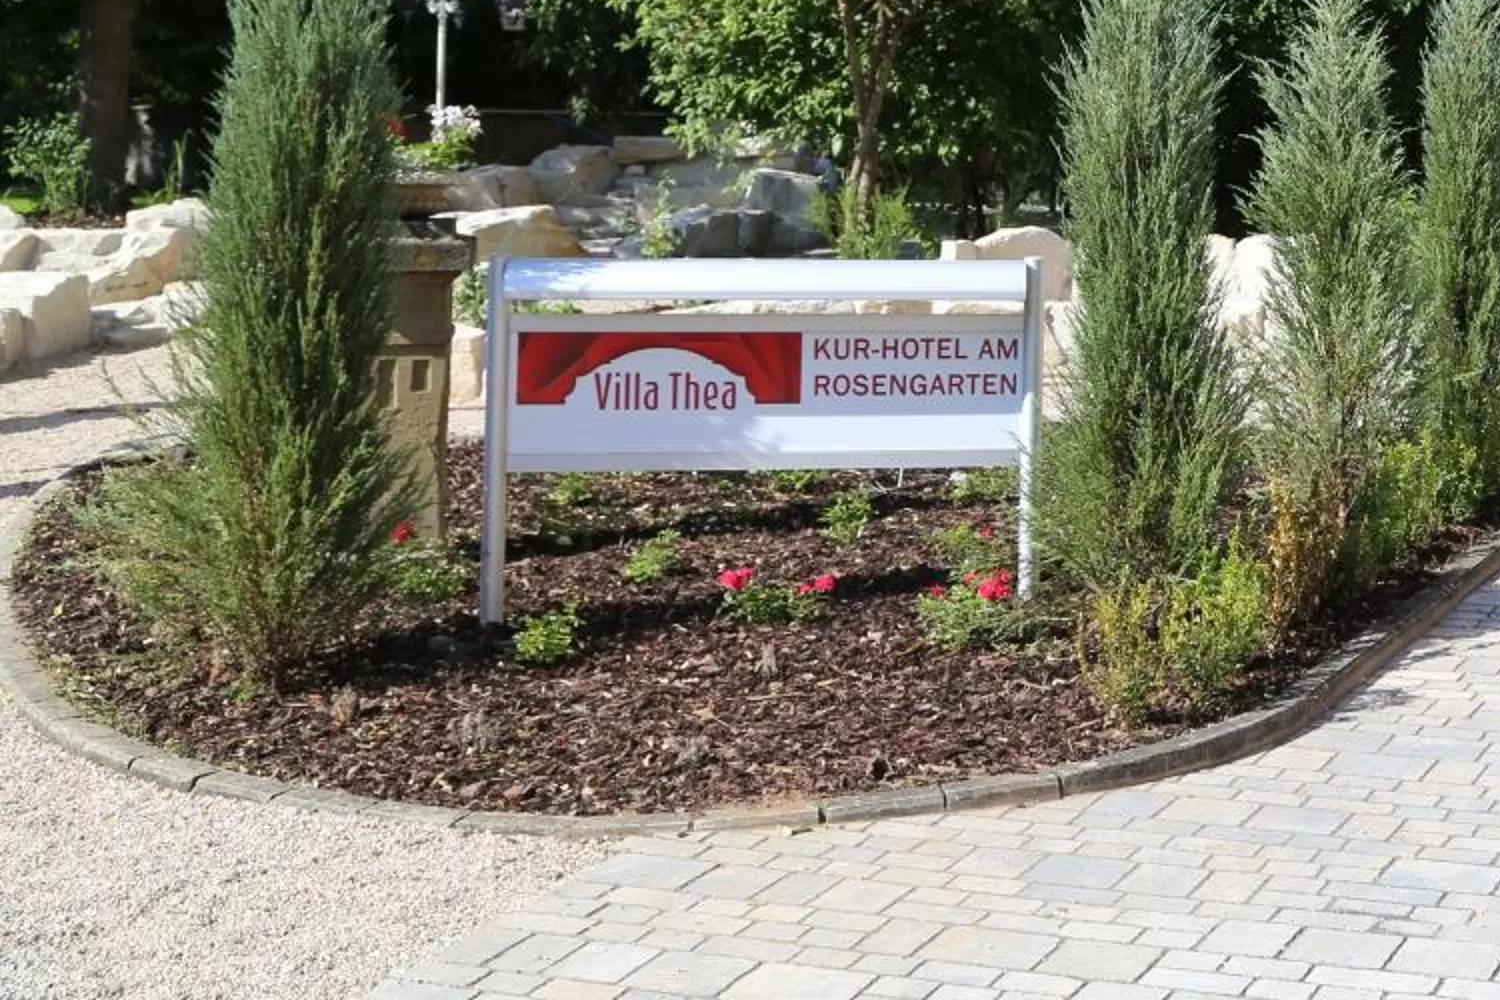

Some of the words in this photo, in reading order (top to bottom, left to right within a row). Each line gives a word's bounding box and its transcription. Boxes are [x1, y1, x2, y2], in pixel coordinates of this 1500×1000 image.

[813, 337, 969, 361] KUR-HOTEL
[977, 337, 1020, 361] AM
[594, 371, 660, 411] Villa
[668, 371, 737, 411] Thea
[813, 372, 1018, 397] ROSENGARTEN
